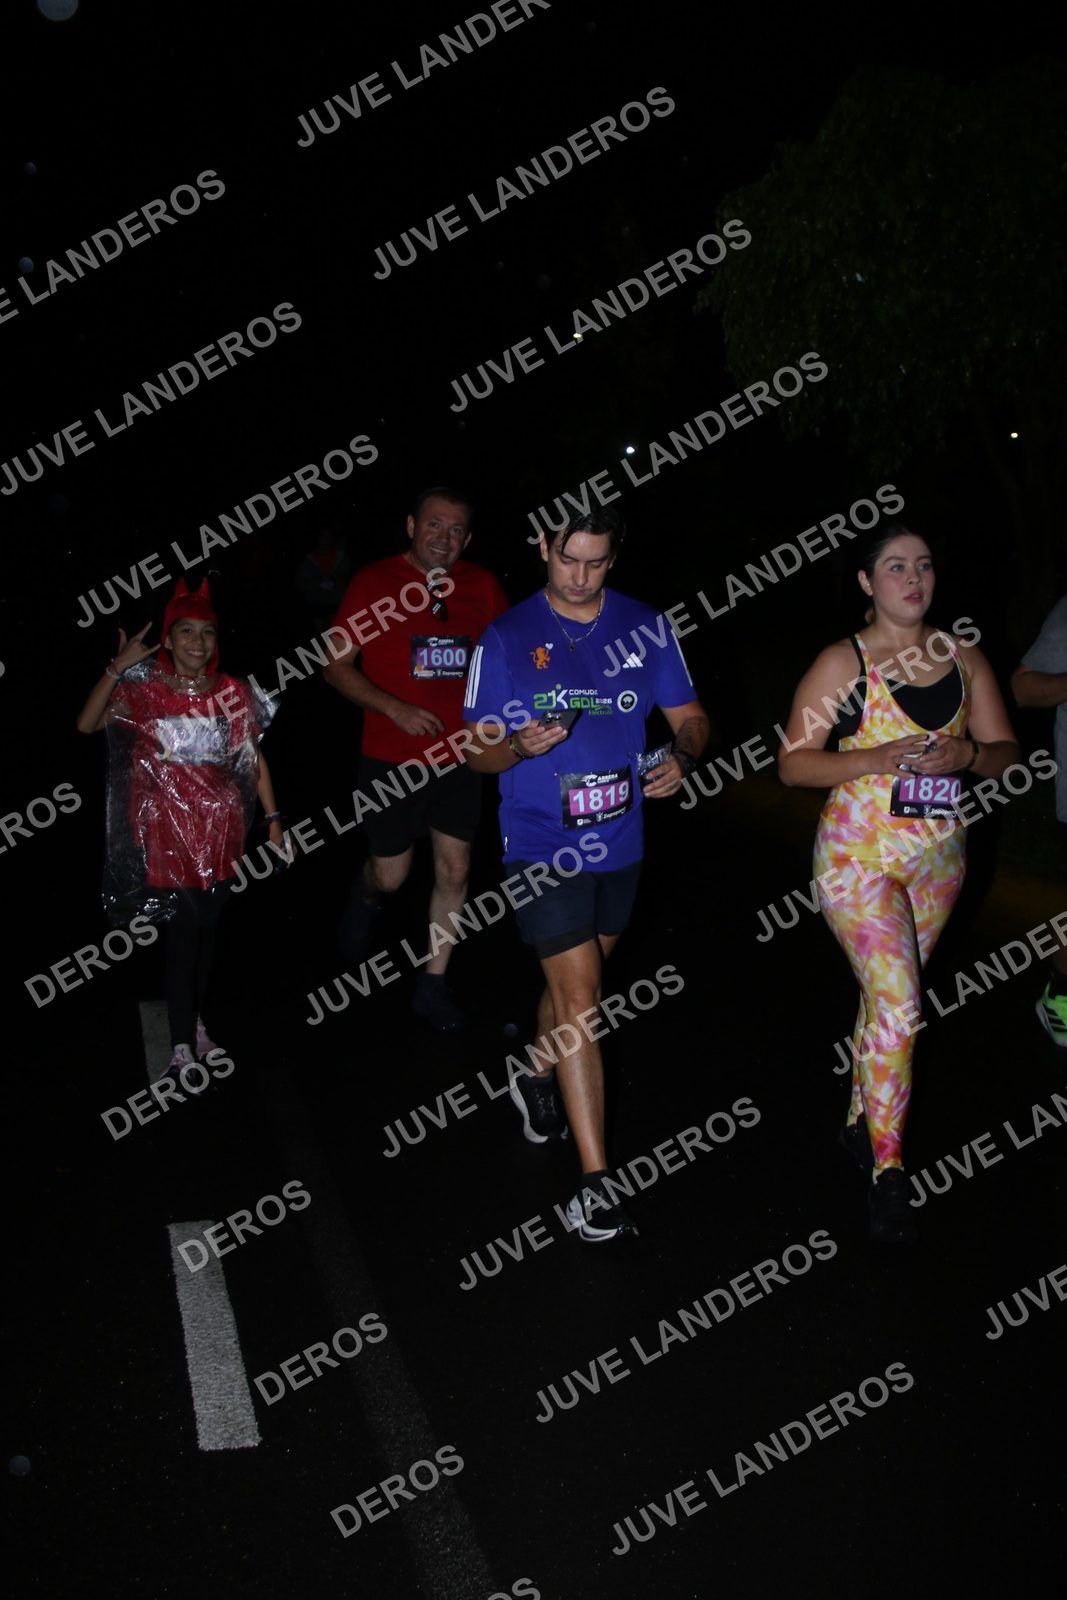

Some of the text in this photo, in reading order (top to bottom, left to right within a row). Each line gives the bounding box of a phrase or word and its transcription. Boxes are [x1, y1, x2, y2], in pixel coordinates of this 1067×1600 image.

[419, 648, 466, 666] 1600
[573, 781, 629, 812] 1819
[904, 777, 961, 801] 1820
